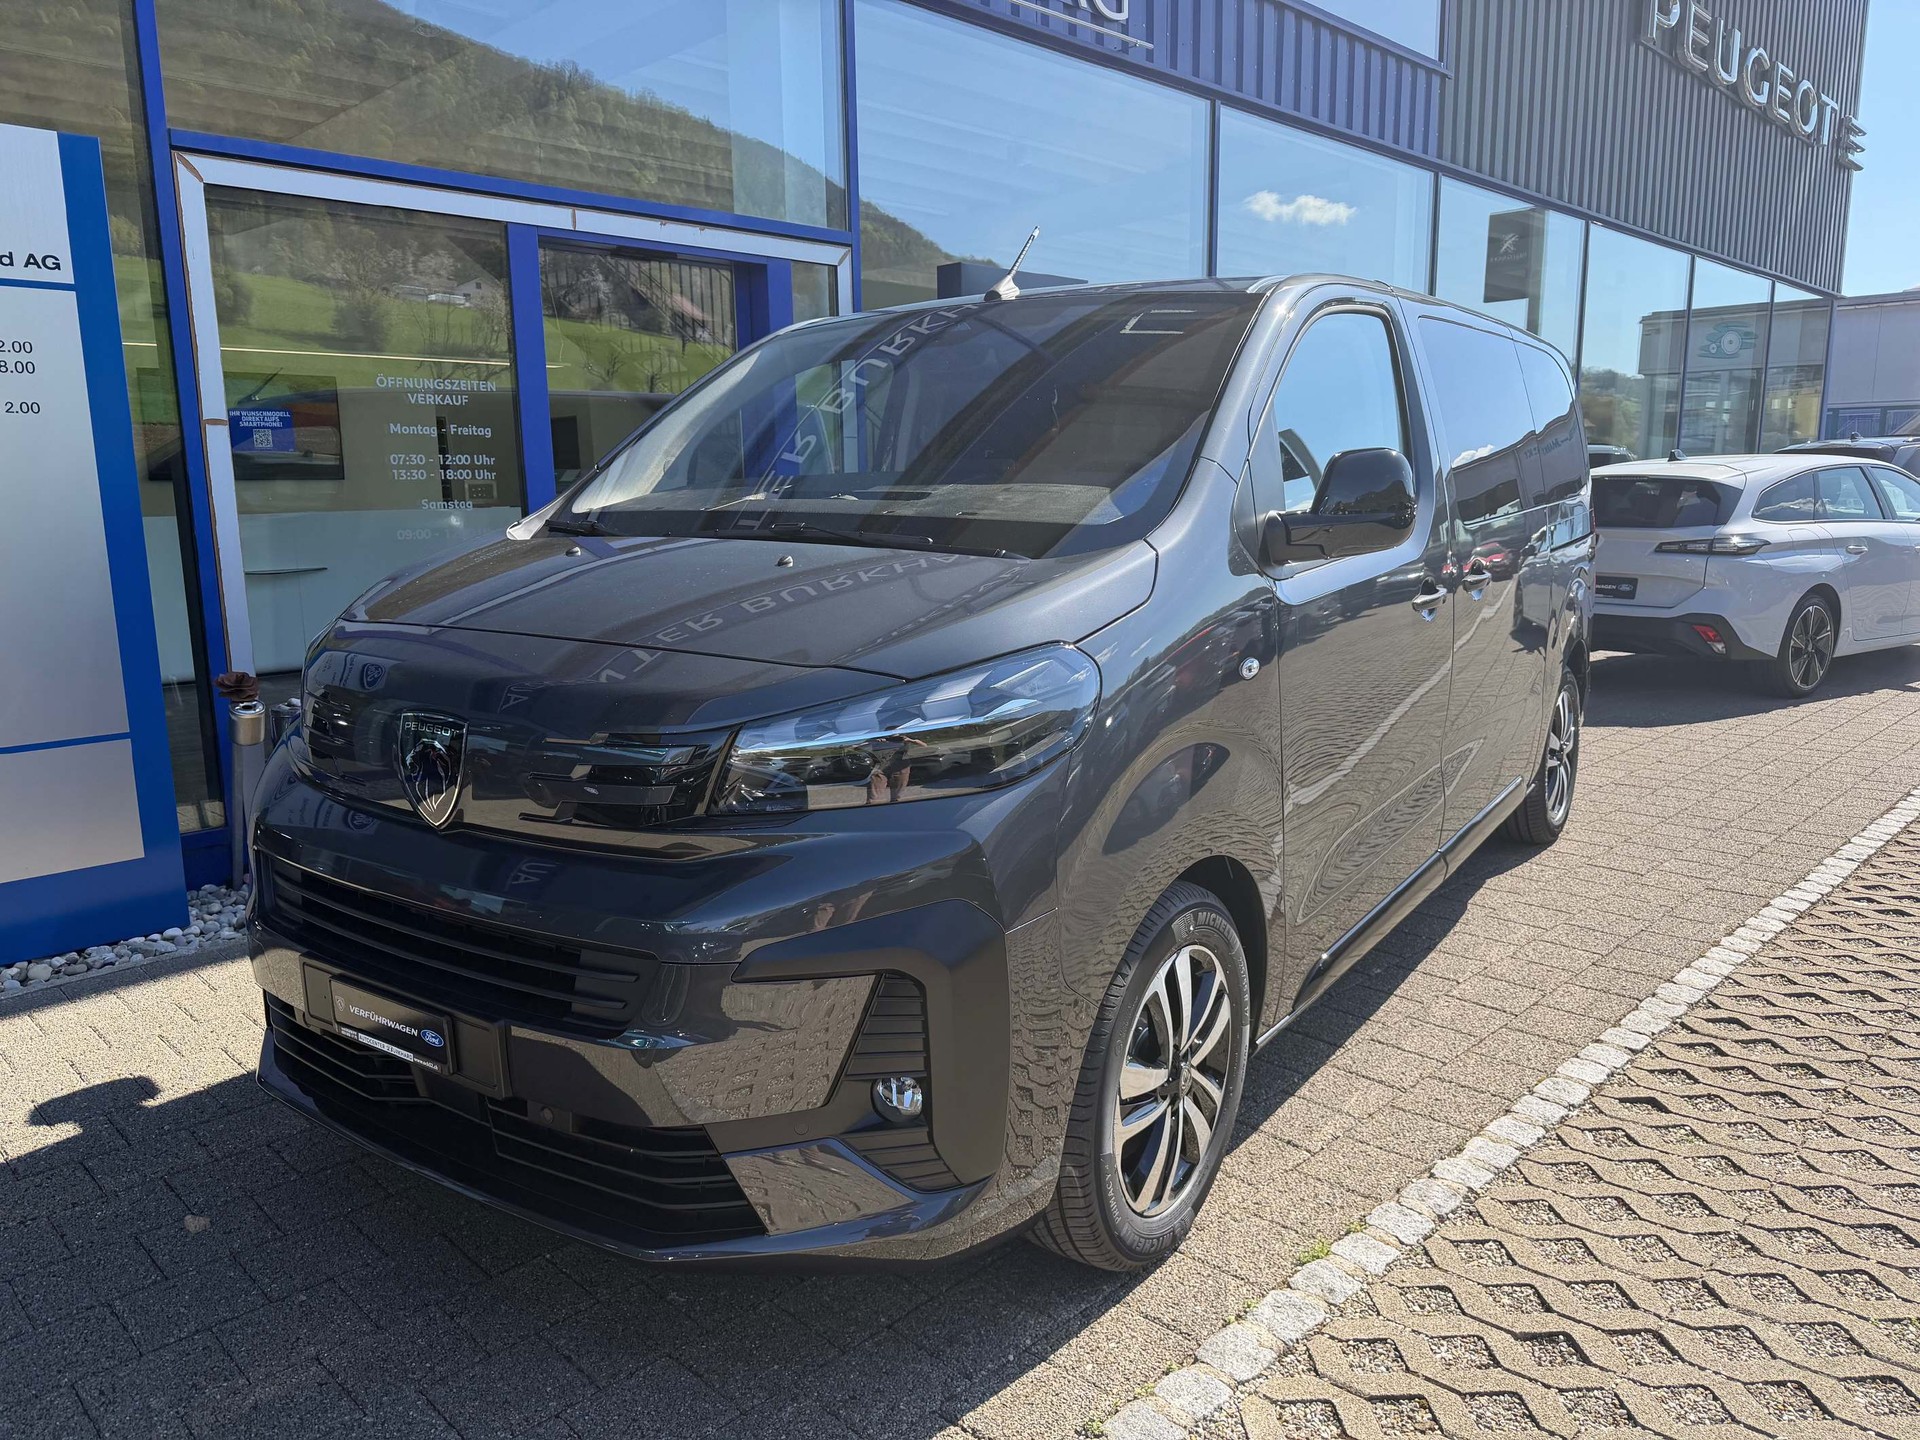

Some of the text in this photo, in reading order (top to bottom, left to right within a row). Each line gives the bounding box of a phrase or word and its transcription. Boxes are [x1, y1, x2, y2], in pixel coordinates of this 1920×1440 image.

[1646, 0, 1838, 147] PEUGEOT
[23, 253, 61, 271] AG
[376, 373, 497, 392] ÖFFNUNGSZEITEN
[408, 393, 469, 406] VERKAUF
[389, 423, 438, 437] Montag
[450, 424, 492, 438] Freitag
[390, 454, 426, 465] 07:30
[438, 454, 471, 465] 12:00
[474, 454, 496, 465] Uhr
[392, 469, 427, 480] 13:30
[439, 469, 472, 480] 18:00
[475, 469, 497, 480] Uhr
[421, 499, 473, 510] Samstag
[404, 721, 460, 737] PEUGEOT
[1196, 911, 1240, 951] MICHELIN
[349, 1004, 419, 1037] VERFÜHRWAGEN
[1105, 1172, 1121, 1224] PRIMACY
